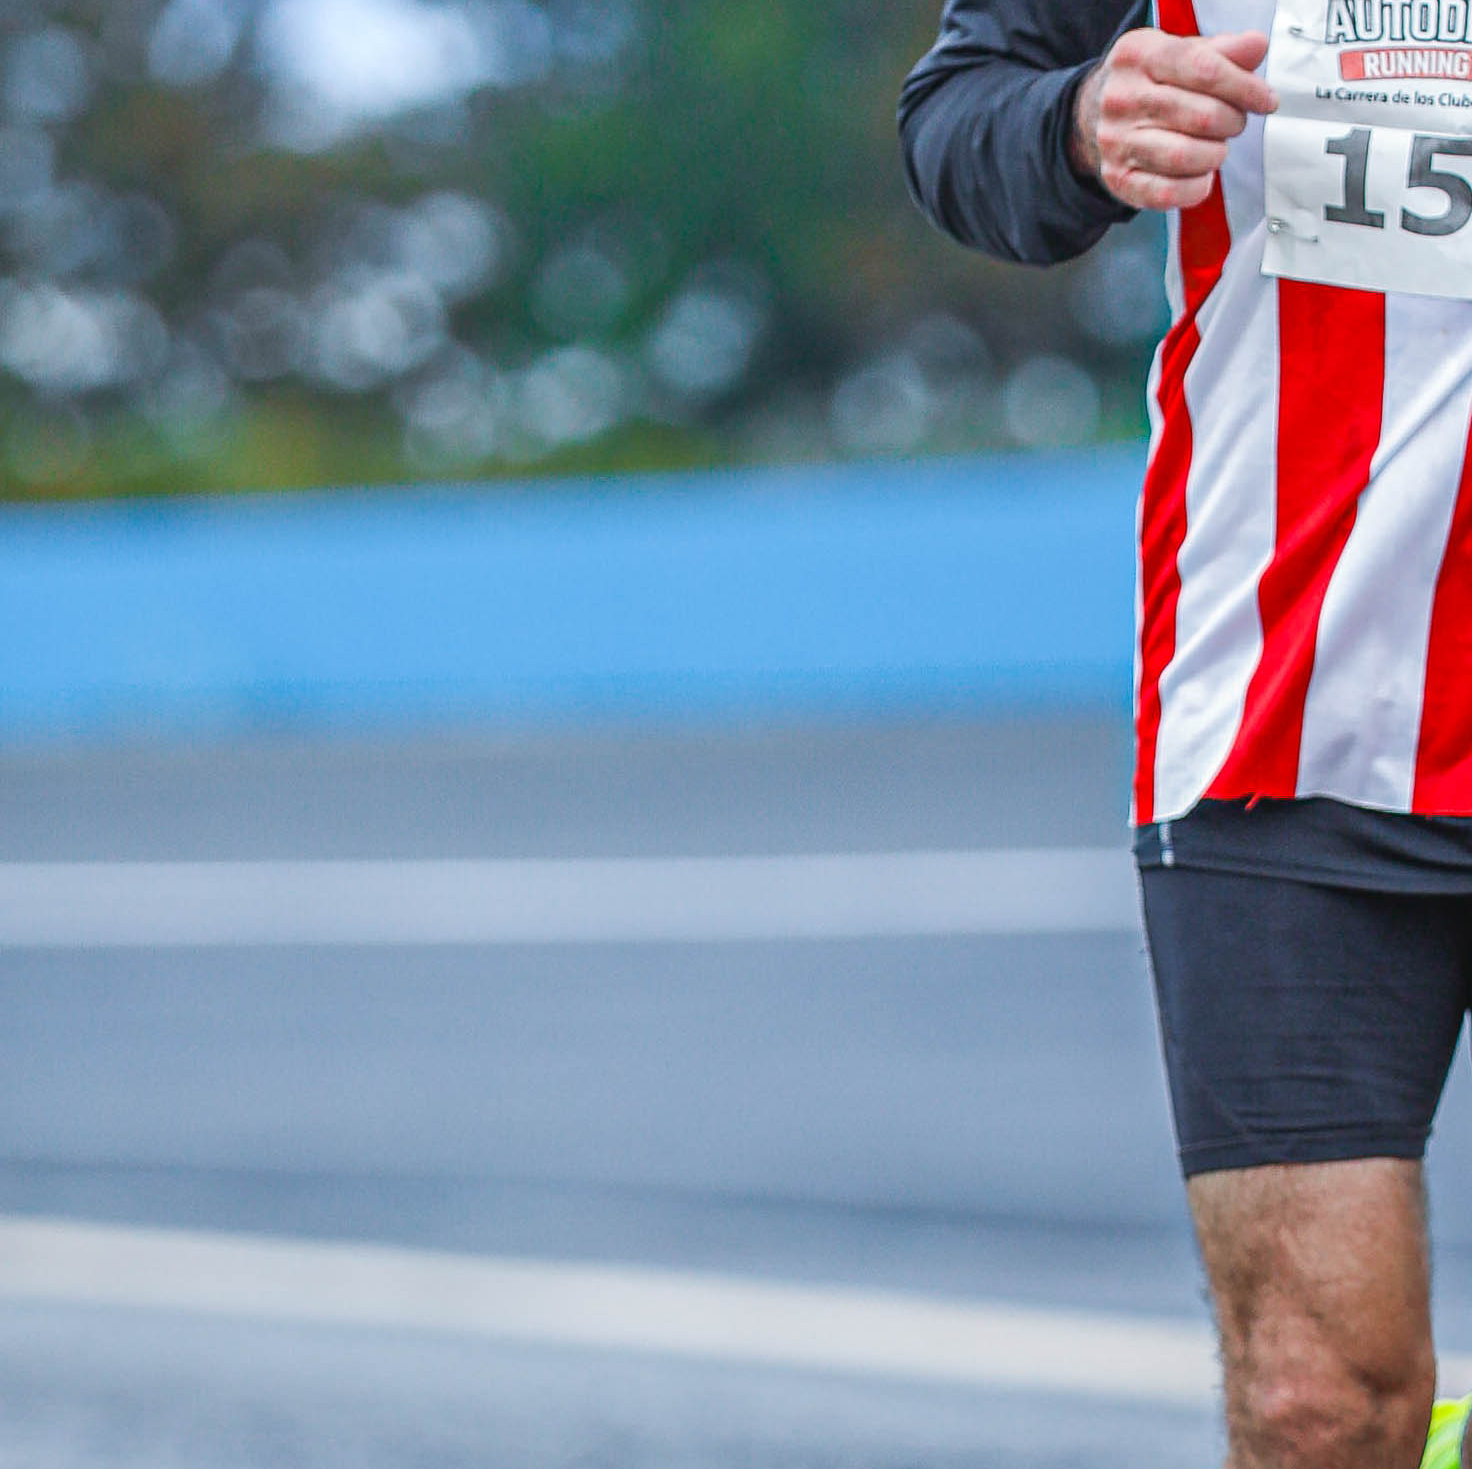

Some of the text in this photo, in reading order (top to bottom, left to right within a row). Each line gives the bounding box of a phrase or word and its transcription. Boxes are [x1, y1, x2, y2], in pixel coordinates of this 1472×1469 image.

[1364, 50, 1470, 79] RUNNING
[1315, 85, 1331, 100] La
[1335, 87, 1388, 103] Carrera
[1392, 90, 1410, 104] de
[1415, 90, 1434, 106] los
